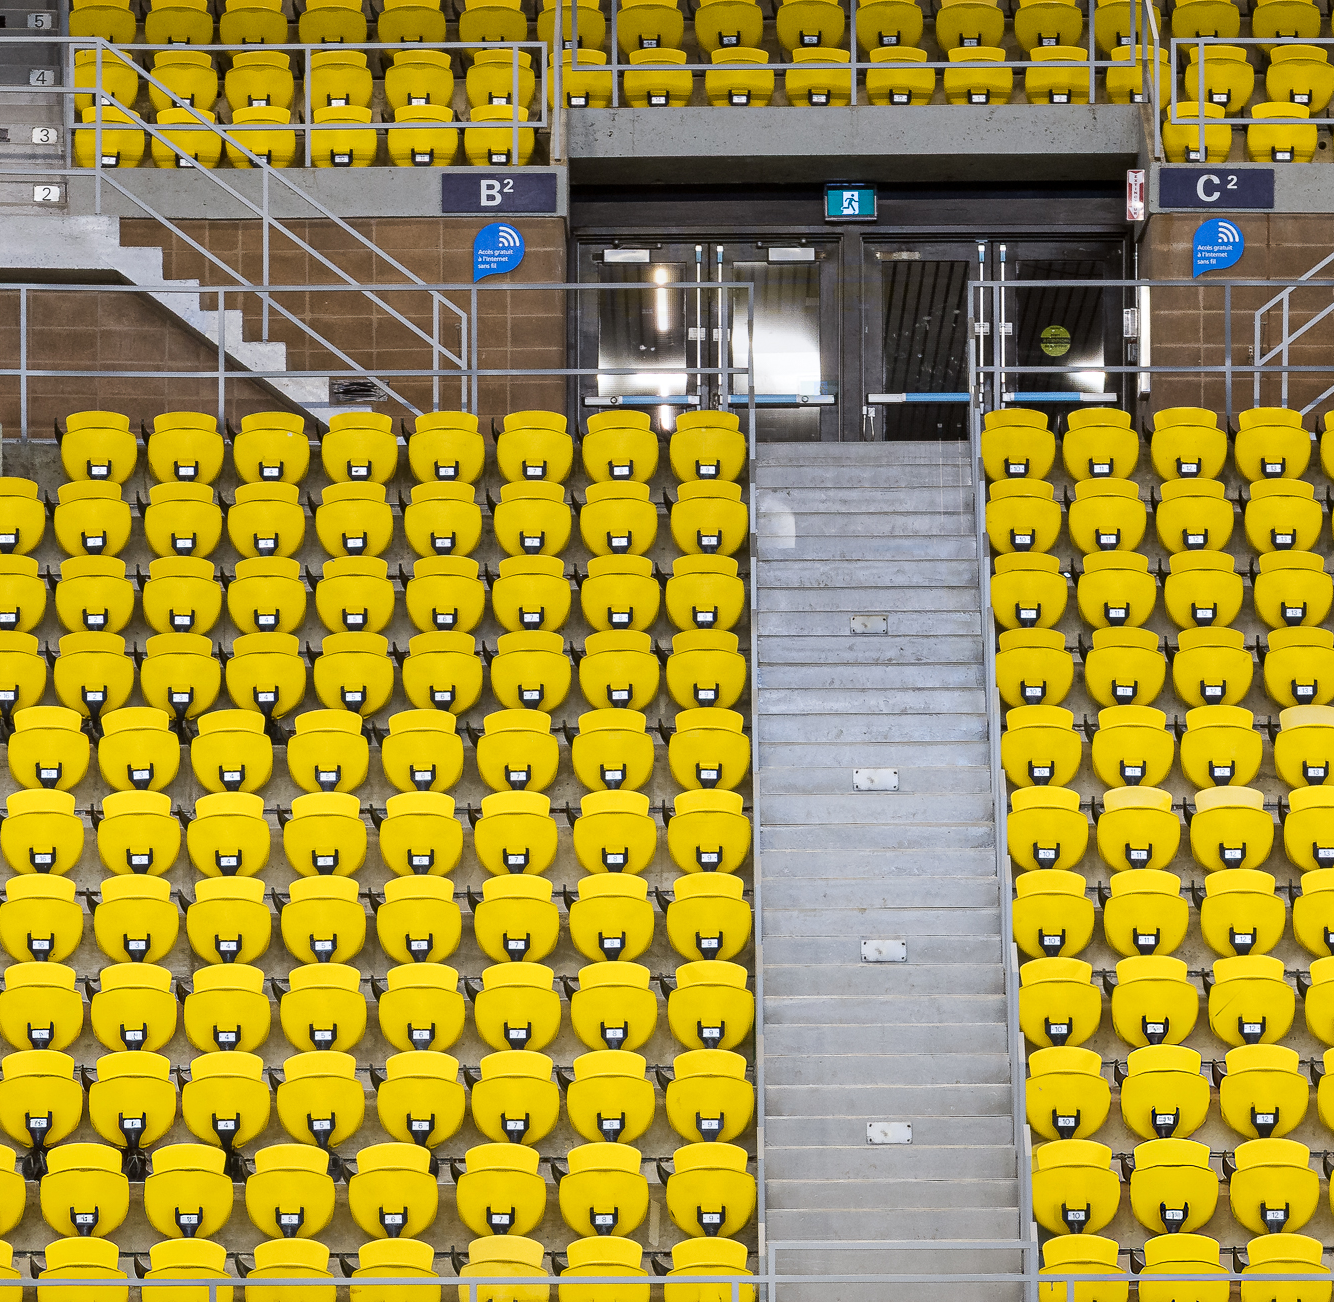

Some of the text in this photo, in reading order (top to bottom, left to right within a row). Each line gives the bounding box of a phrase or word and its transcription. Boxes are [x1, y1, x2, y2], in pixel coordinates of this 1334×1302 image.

[34, 14, 44, 28] 5
[35, 71, 47, 84] 4
[39, 128, 50, 142] 3
[42, 187, 52, 201] 2
[1213, 244, 1233, 252] gratuit
